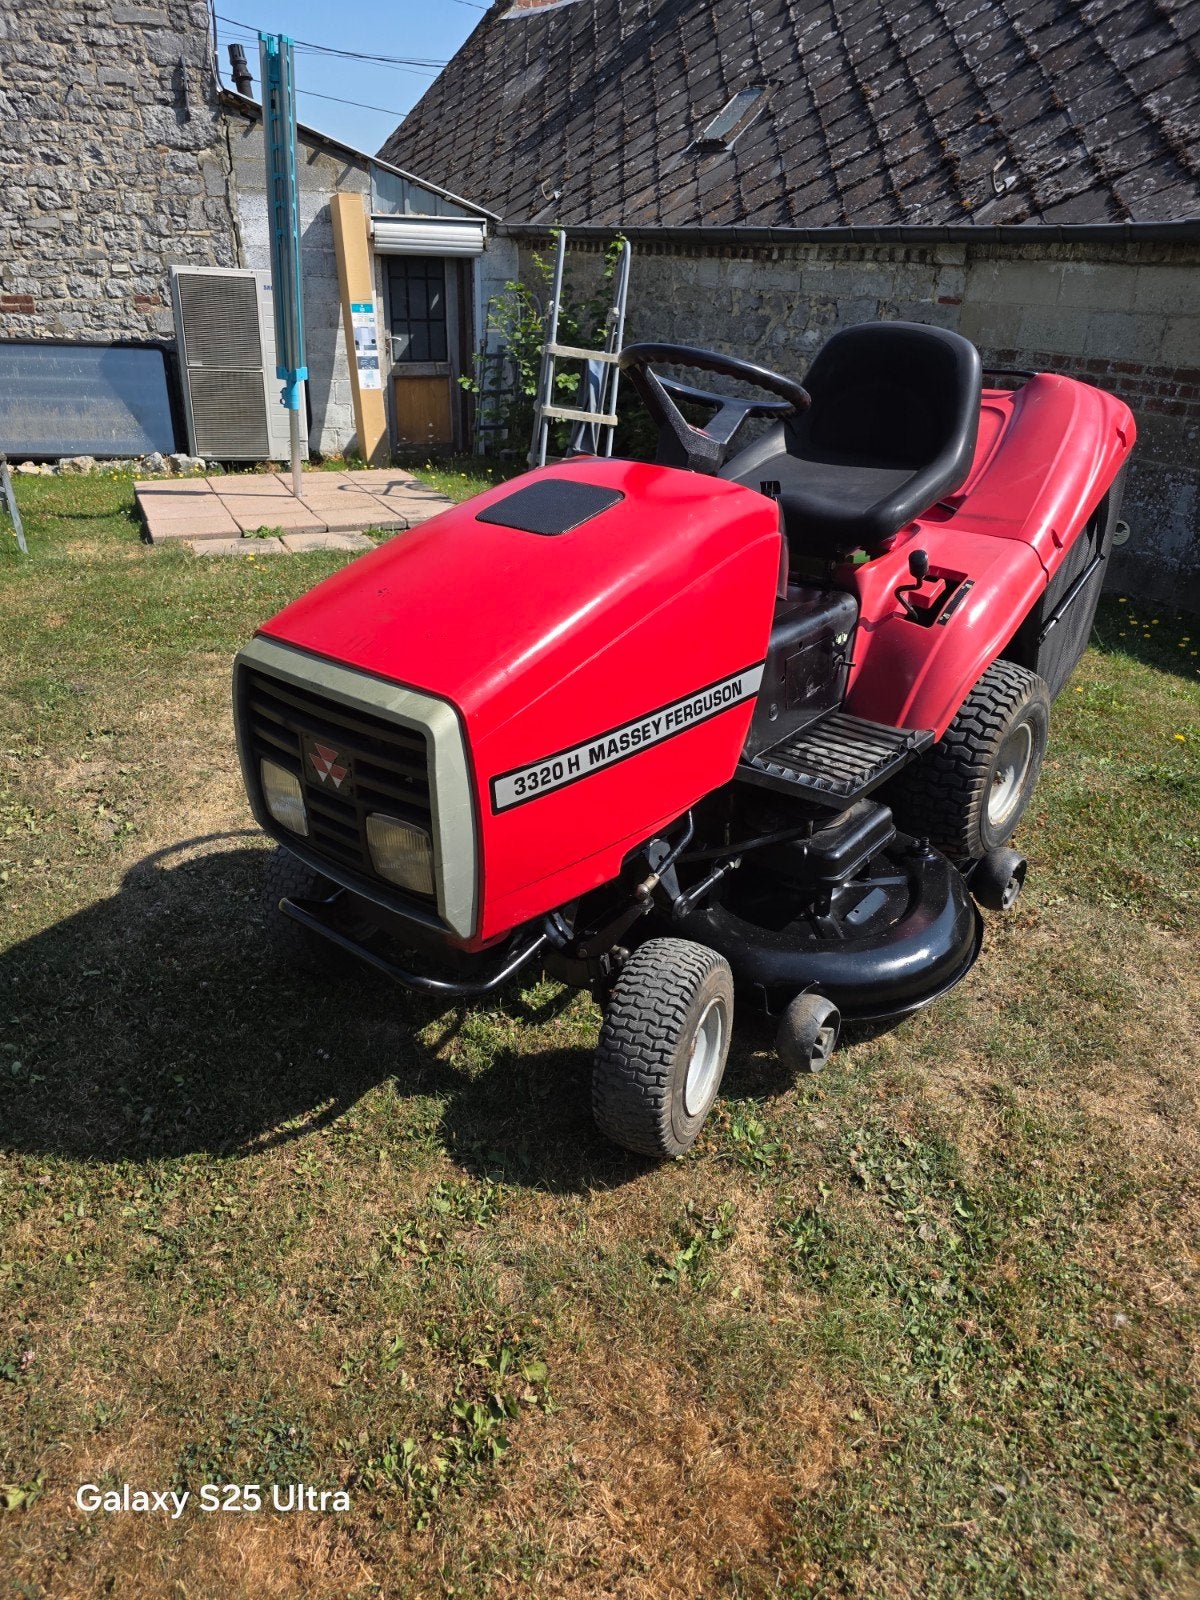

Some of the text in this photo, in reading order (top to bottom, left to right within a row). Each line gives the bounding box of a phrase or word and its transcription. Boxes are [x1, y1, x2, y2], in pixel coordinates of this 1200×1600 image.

[514, 680, 743, 796] 3320 H MASSEY FERGUSON
